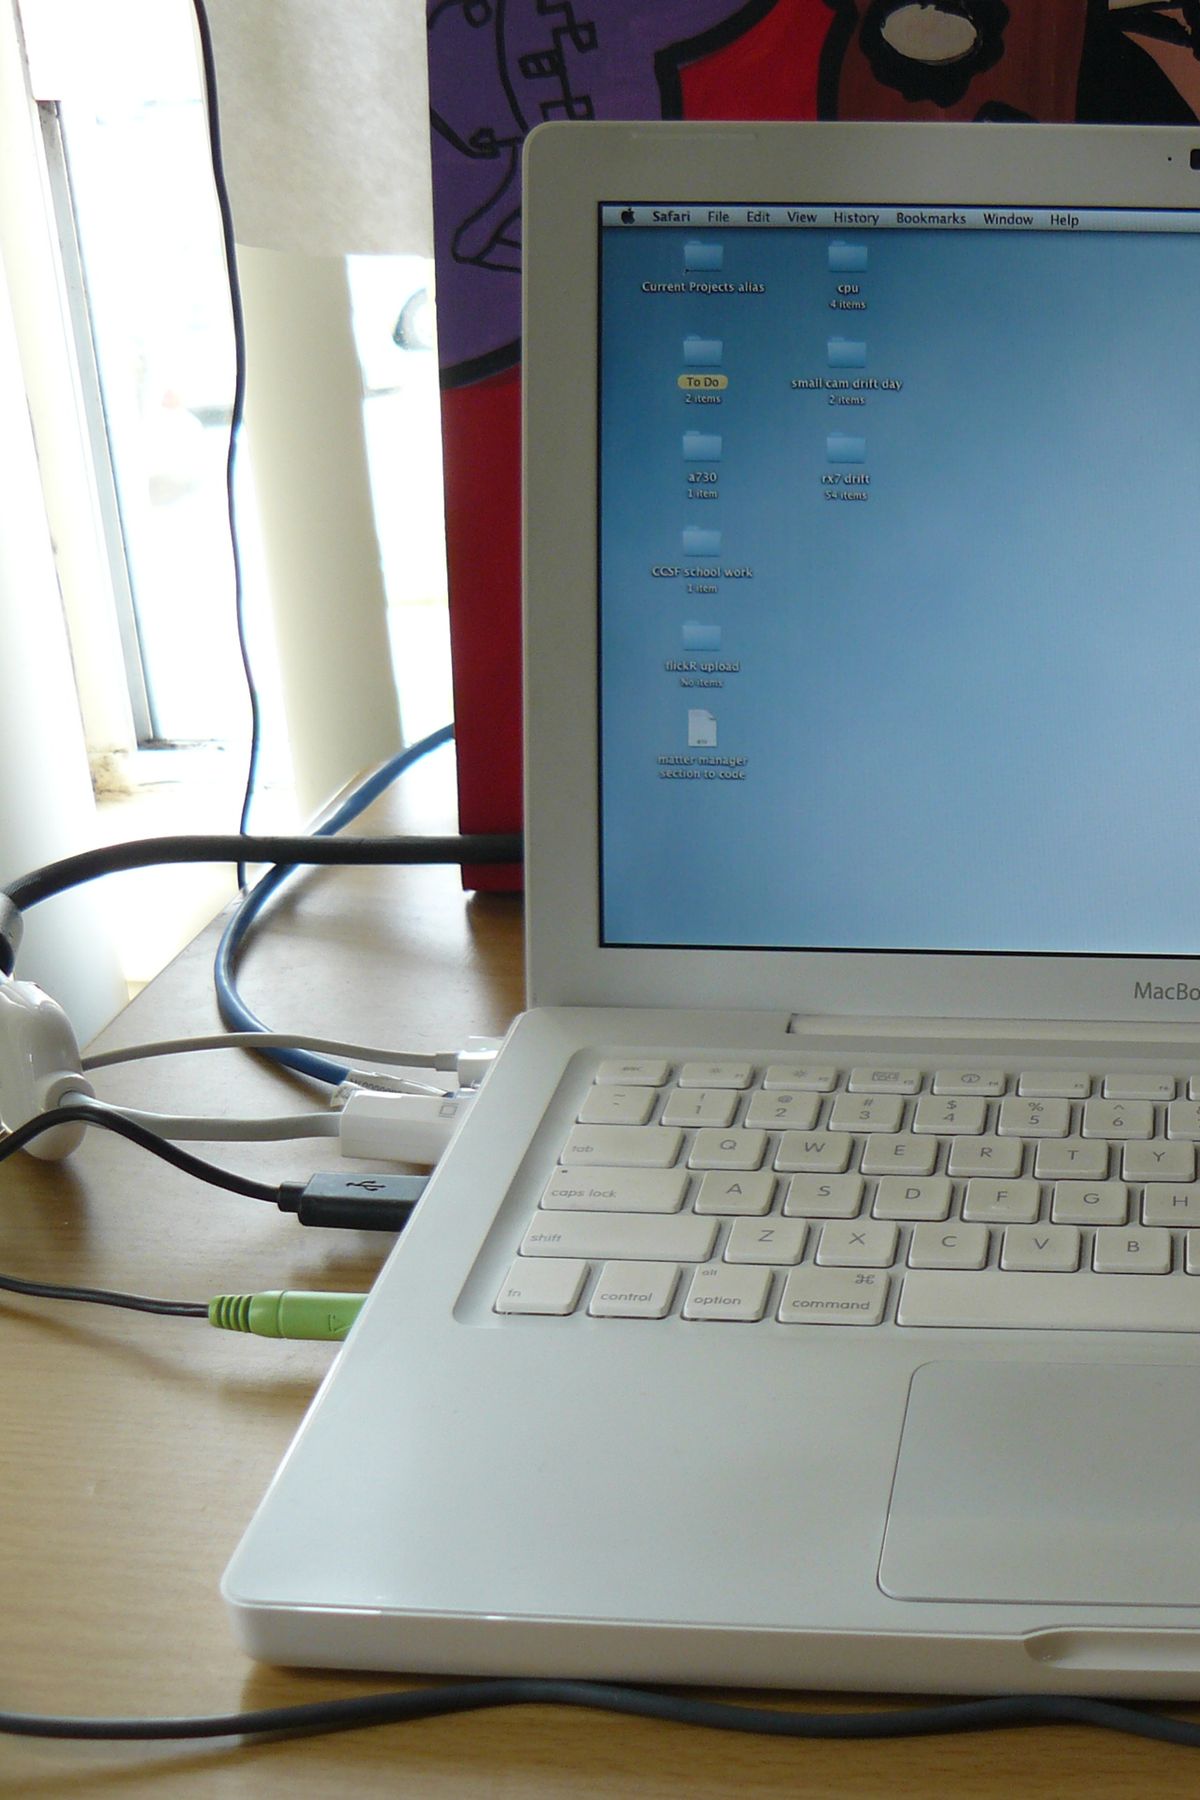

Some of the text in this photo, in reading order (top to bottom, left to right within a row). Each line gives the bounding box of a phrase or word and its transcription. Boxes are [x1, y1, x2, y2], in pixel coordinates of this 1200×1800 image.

[653, 211, 1079, 228] Safari File Edit View History Bookmarks Window Help
[642, 281, 766, 294] Current Projects alias
[837, 283, 859, 295] cpu
[829, 300, 867, 310] 4 items
[687, 376, 719, 388] To Do
[791, 378, 902, 392] small cam drift day
[685, 394, 721, 404] 2 items
[828, 395, 865, 405] 2 items
[688, 472, 718, 484] a730
[821, 473, 871, 485] rx7 drift
[687, 488, 718, 499] 1 item
[839, 490, 867, 501] items
[652, 567, 753, 578] CCSF school work
[688, 584, 718, 593] 1 item
[700, 661, 740, 674] upload
[696, 677, 723, 688] items
[657, 755, 748, 768] matter manager
[660, 769, 746, 779] section to code
[775, 1107, 788, 1118] 2
[858, 1110, 871, 1121] 3
[942, 1112, 955, 1123] 4
[1028, 1114, 1040, 1125] 5
[1112, 1116, 1124, 1127] 6
[571, 1144, 595, 1153] tab
[719, 1139, 738, 1151] Q
[804, 1141, 826, 1153] W
[893, 1144, 906, 1156] E
[979, 1146, 993, 1158] R
[1067, 1149, 1079, 1161] T
[1152, 1151, 1166, 1163] Y
[551, 1188, 617, 1199] caps lock
[725, 1183, 743, 1195] A
[817, 1185, 831, 1197] S
[904, 1187, 921, 1200] D
[996, 1190, 1008, 1202] F
[1082, 1192, 1100, 1205] G
[1172, 1195, 1189, 1207] H
[530, 1233, 563, 1243] shift
[757, 1229, 776, 1243] Z
[848, 1232, 866, 1246] X
[941, 1235, 958, 1248] C
[1033, 1237, 1050, 1250] V
[1127, 1240, 1140, 1253] B
[600, 1292, 654, 1302] control
[693, 1295, 742, 1306] option
[791, 1300, 871, 1311] command
